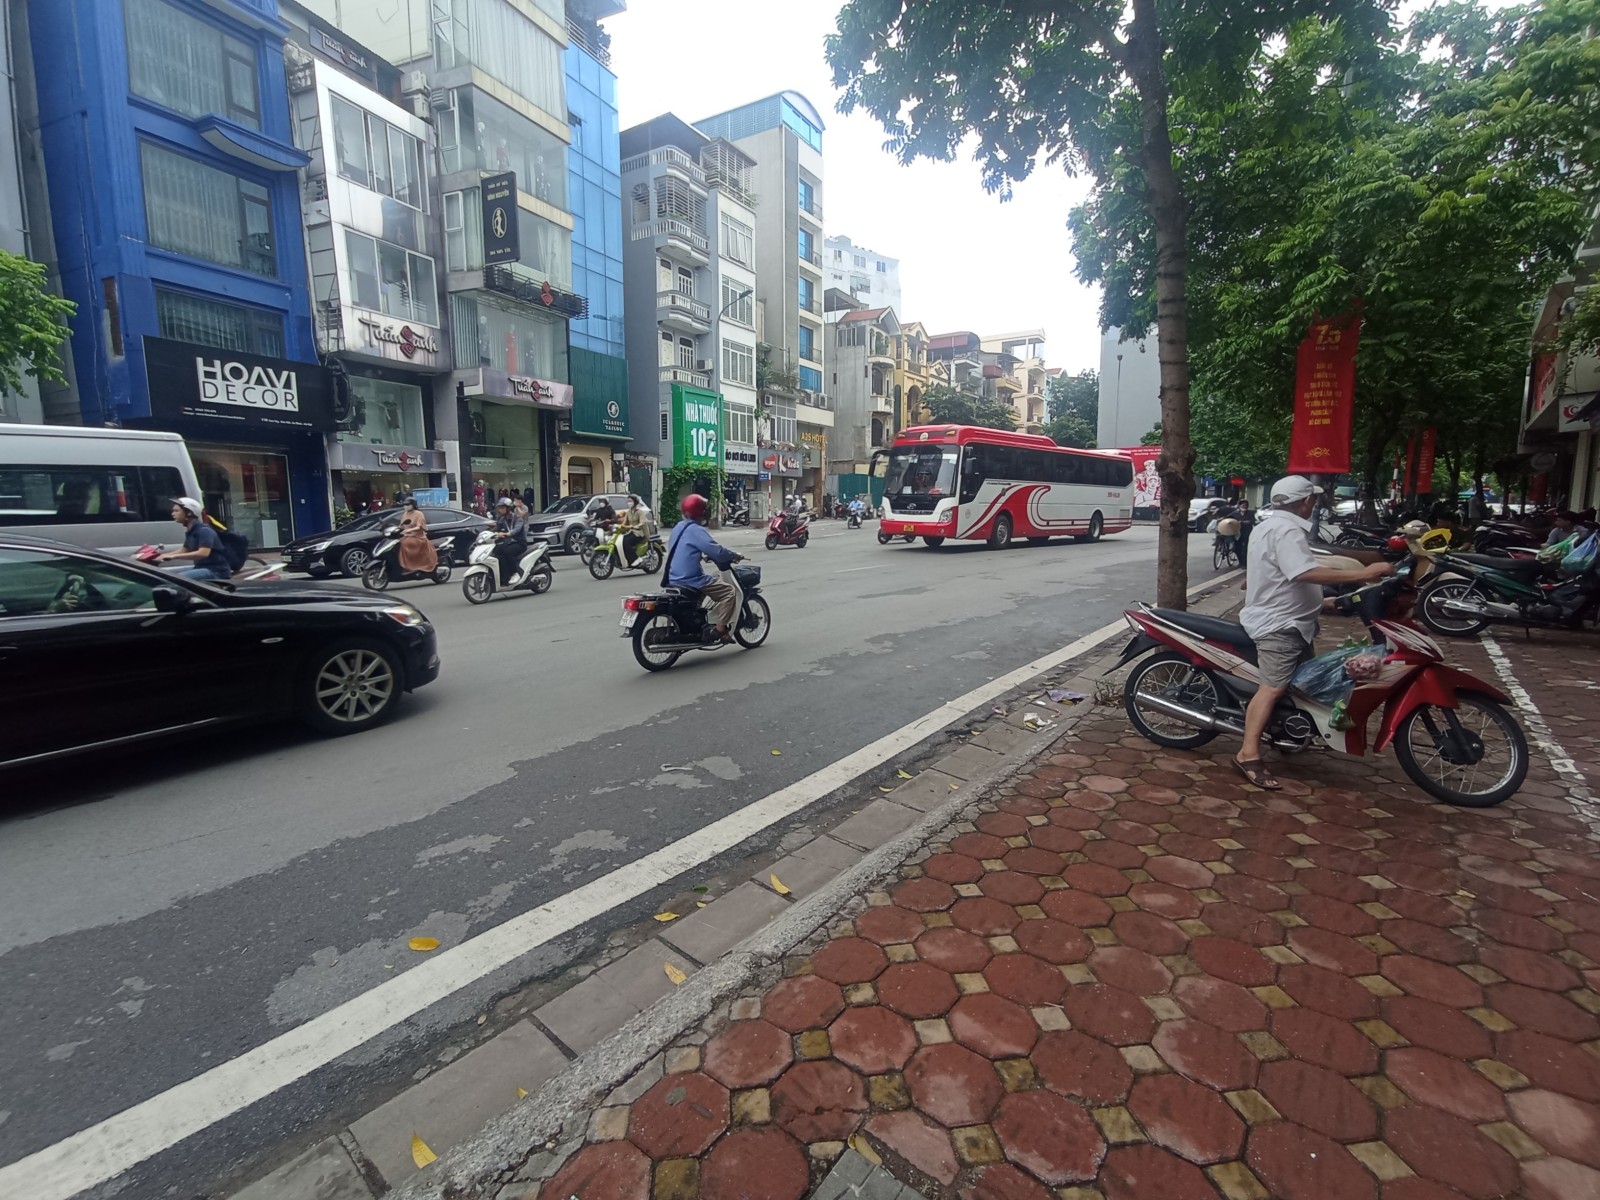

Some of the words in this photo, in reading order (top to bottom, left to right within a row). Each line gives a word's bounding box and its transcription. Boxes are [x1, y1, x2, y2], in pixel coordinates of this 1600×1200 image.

[358, 317, 404, 348] Tuấn
[196, 357, 296, 390] HOAVI
[202, 380, 297, 409] DECOR
[685, 400, 699, 423] NHÀ
[691, 428, 717, 457] 102
[372, 449, 402, 467] Tuấn
